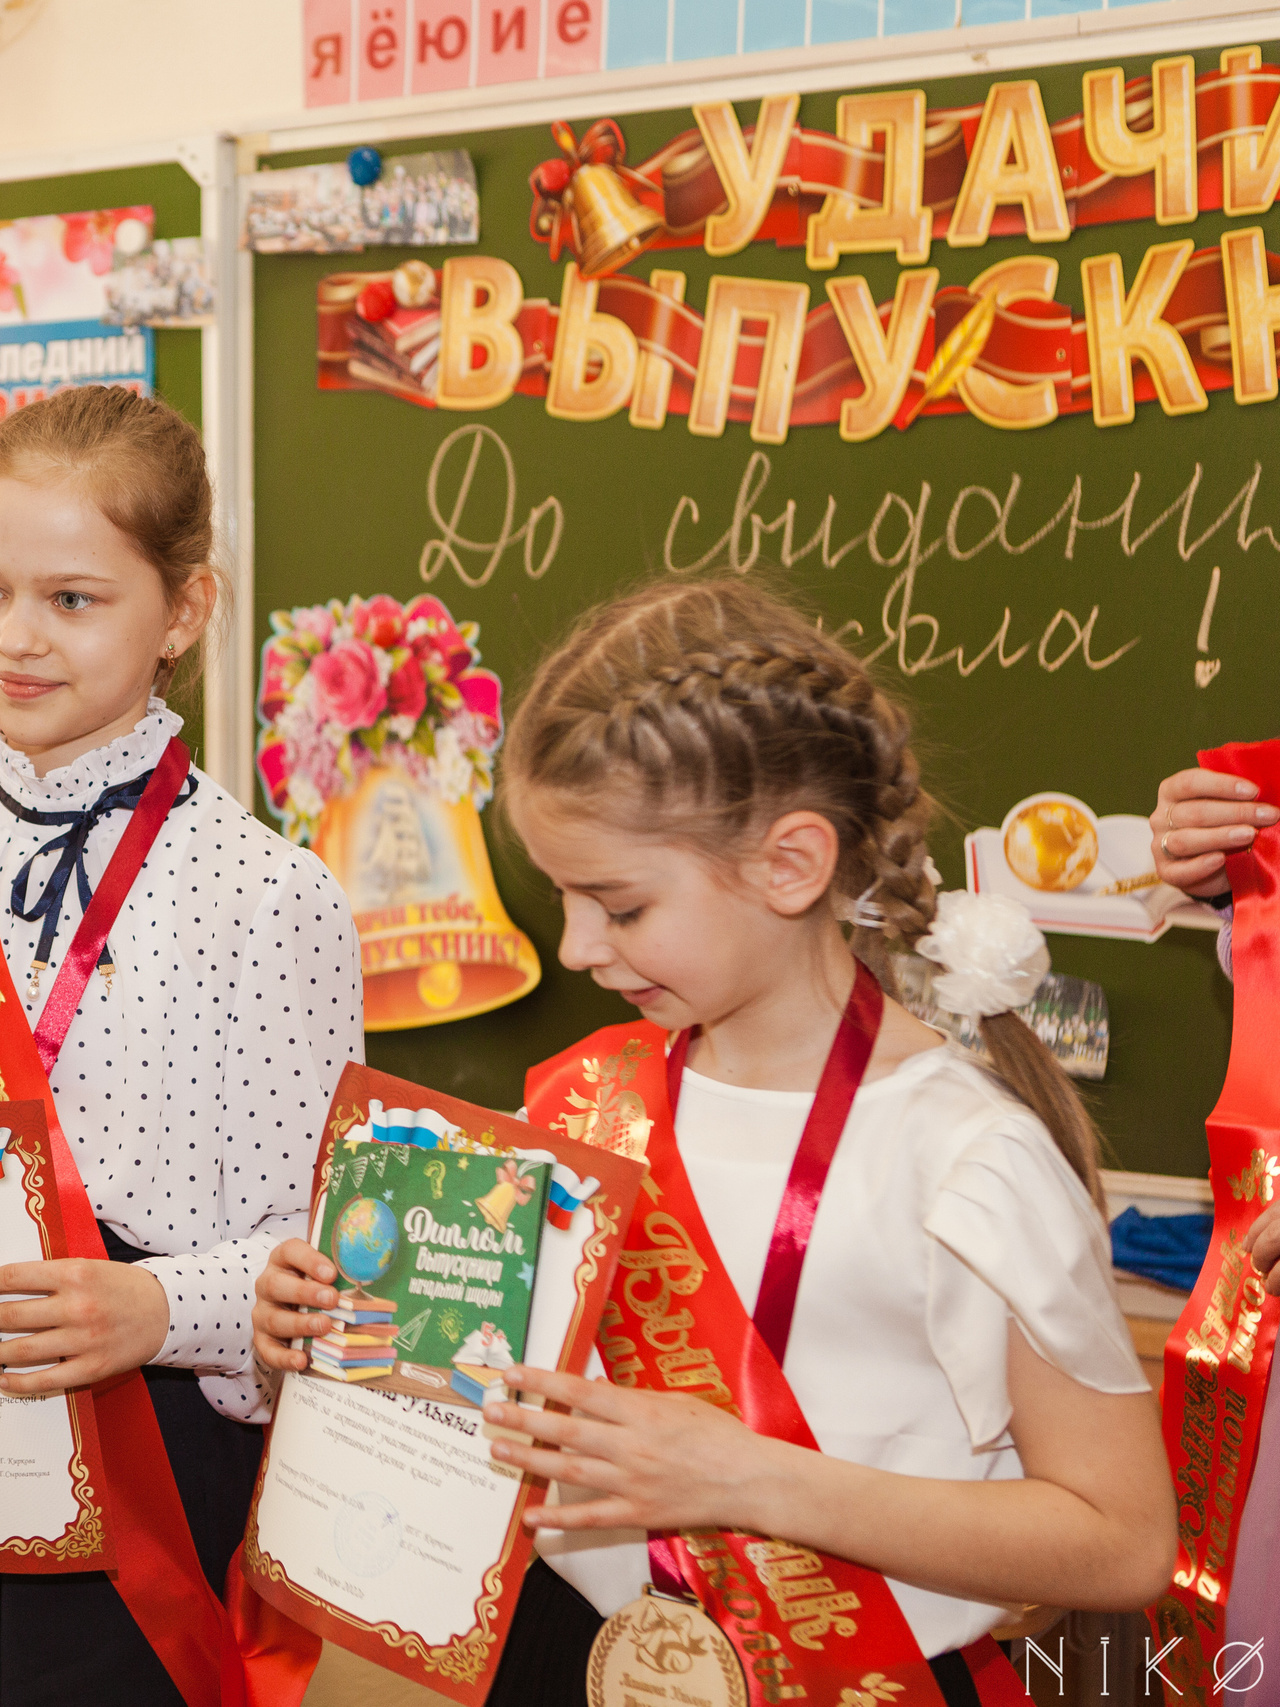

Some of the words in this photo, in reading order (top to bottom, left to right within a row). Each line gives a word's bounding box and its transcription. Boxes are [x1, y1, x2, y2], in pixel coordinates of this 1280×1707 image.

[366, 8, 398, 70] ё
[417, 15, 468, 64] ю
[492, 6, 526, 55] и
[419, 424, 564, 587] До
[665, 449, 1280, 630] свидани
[403, 1205, 526, 1256] Диплом
[1195, 1386, 1248, 1633] начальной
